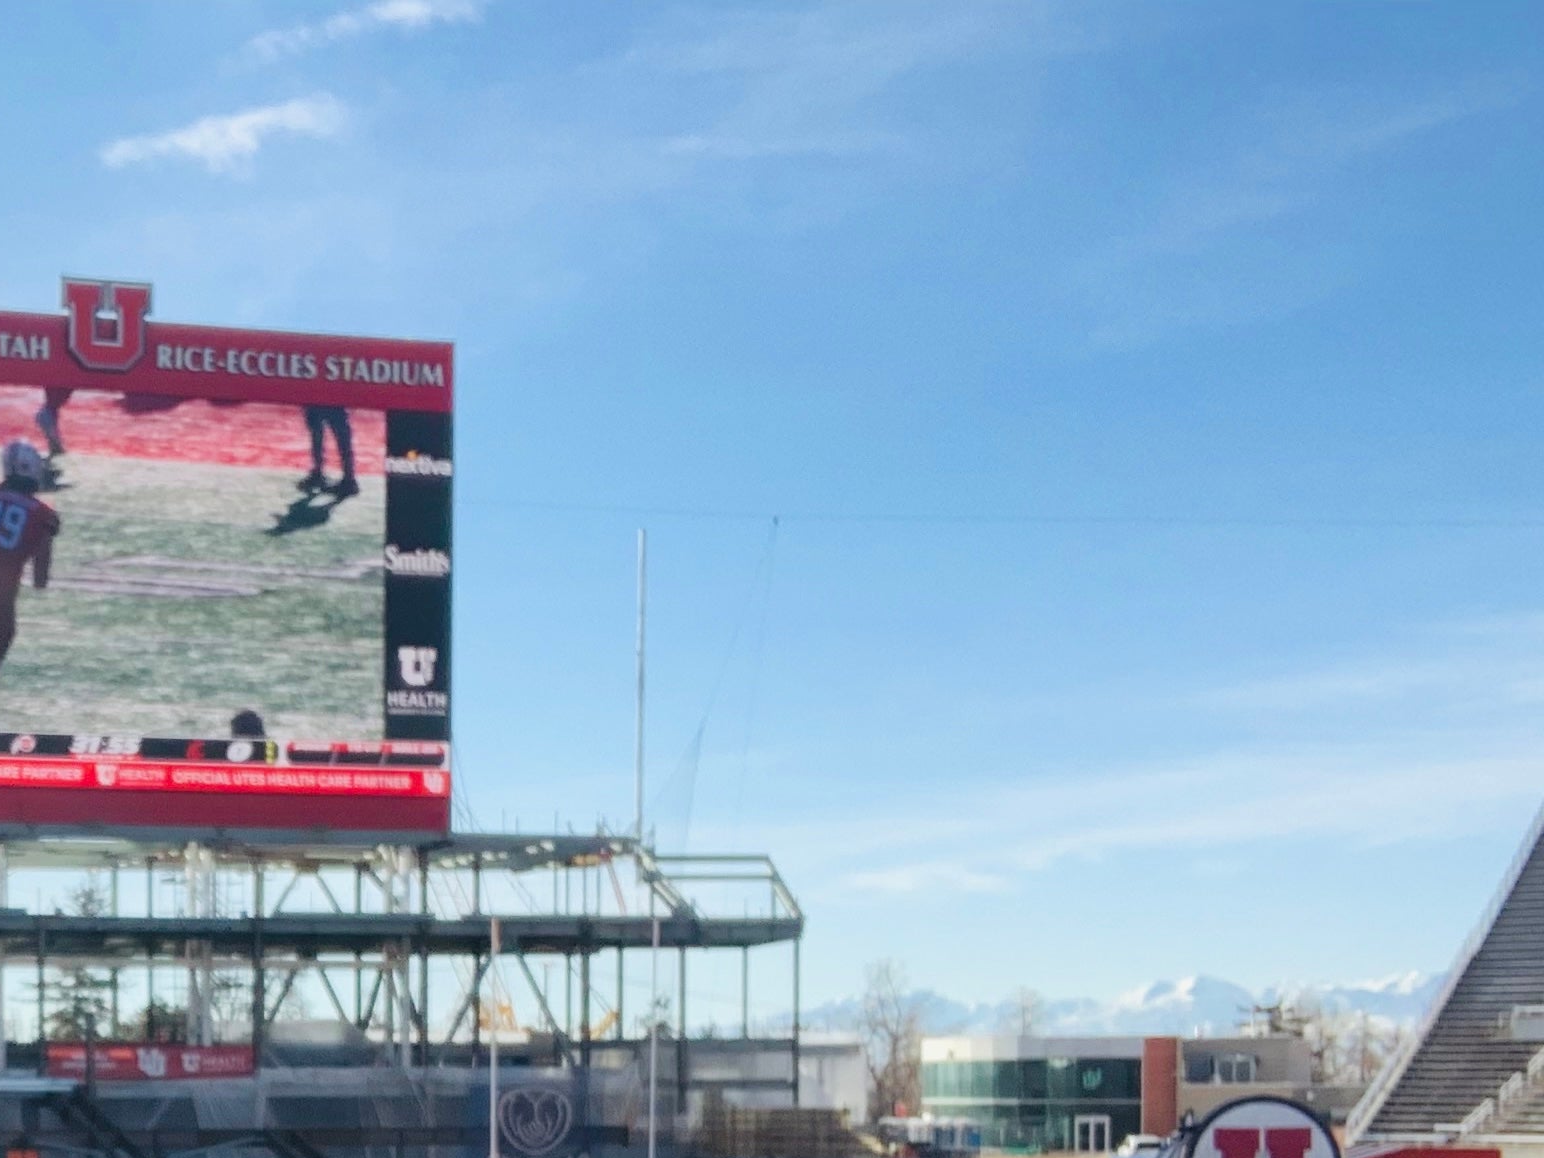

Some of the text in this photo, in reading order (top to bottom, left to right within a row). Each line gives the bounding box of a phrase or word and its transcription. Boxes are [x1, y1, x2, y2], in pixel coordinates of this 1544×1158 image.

[61, 277, 152, 373] U
[156, 342, 445, 387] RICE-ECCLES STADIUM
[398, 647, 438, 687] U
[387, 691, 447, 708] HEALTH
[23, 766, 84, 781] PARTNER
[119, 769, 165, 783] HEALTH
[173, 770, 230, 786] OFFICIAL
[233, 772, 265, 787] UTES
[267, 773, 315, 788] HEALTH
[318, 775, 353, 788] CARE
[355, 775, 412, 790] PARTNER
